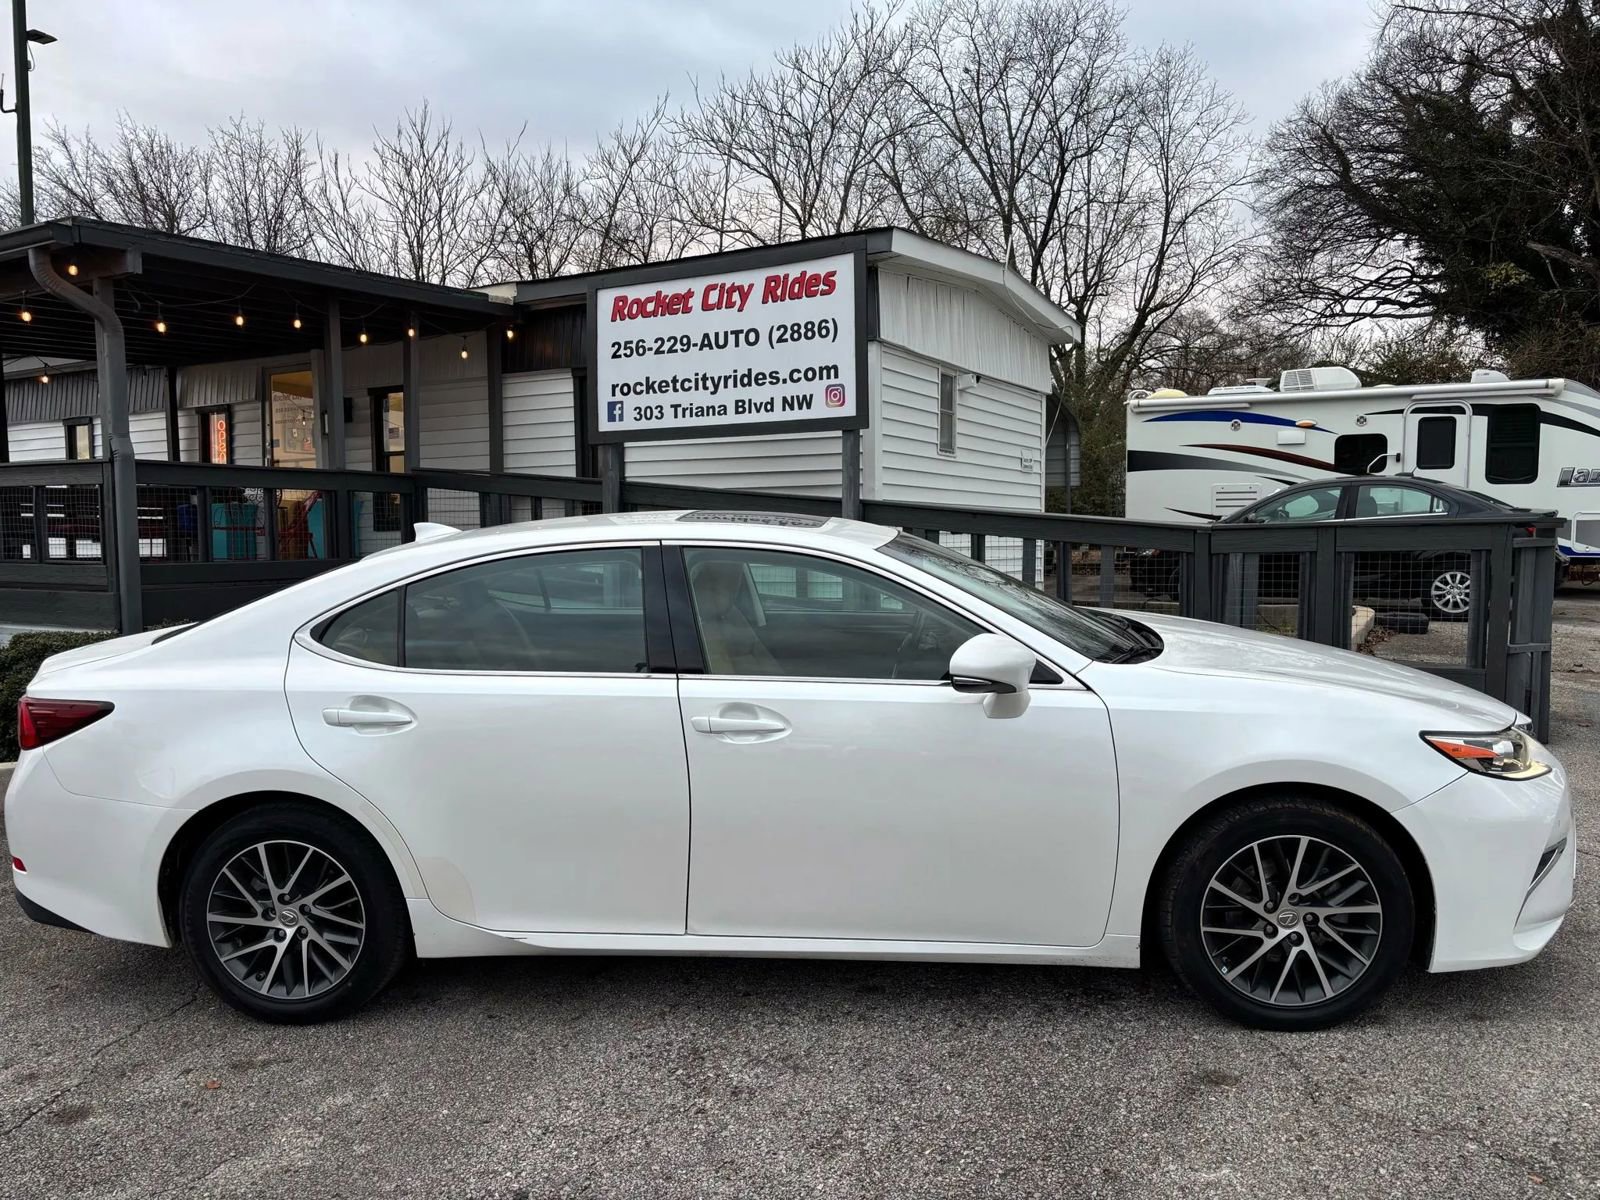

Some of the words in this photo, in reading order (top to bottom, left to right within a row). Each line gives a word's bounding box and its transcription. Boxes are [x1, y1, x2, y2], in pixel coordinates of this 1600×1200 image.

[611, 288, 695, 322] Rocket
[701, 282, 754, 312] City
[761, 270, 837, 304] Rides
[611, 328, 760, 359] 256-229-AUTO
[768, 318, 838, 349] (2886)
[611, 364, 839, 397] rocketcityrides.com
[633, 405, 665, 421] 303
[670, 402, 728, 419] Triana
[734, 397, 775, 415] Blvd
[782, 394, 814, 412] NW
